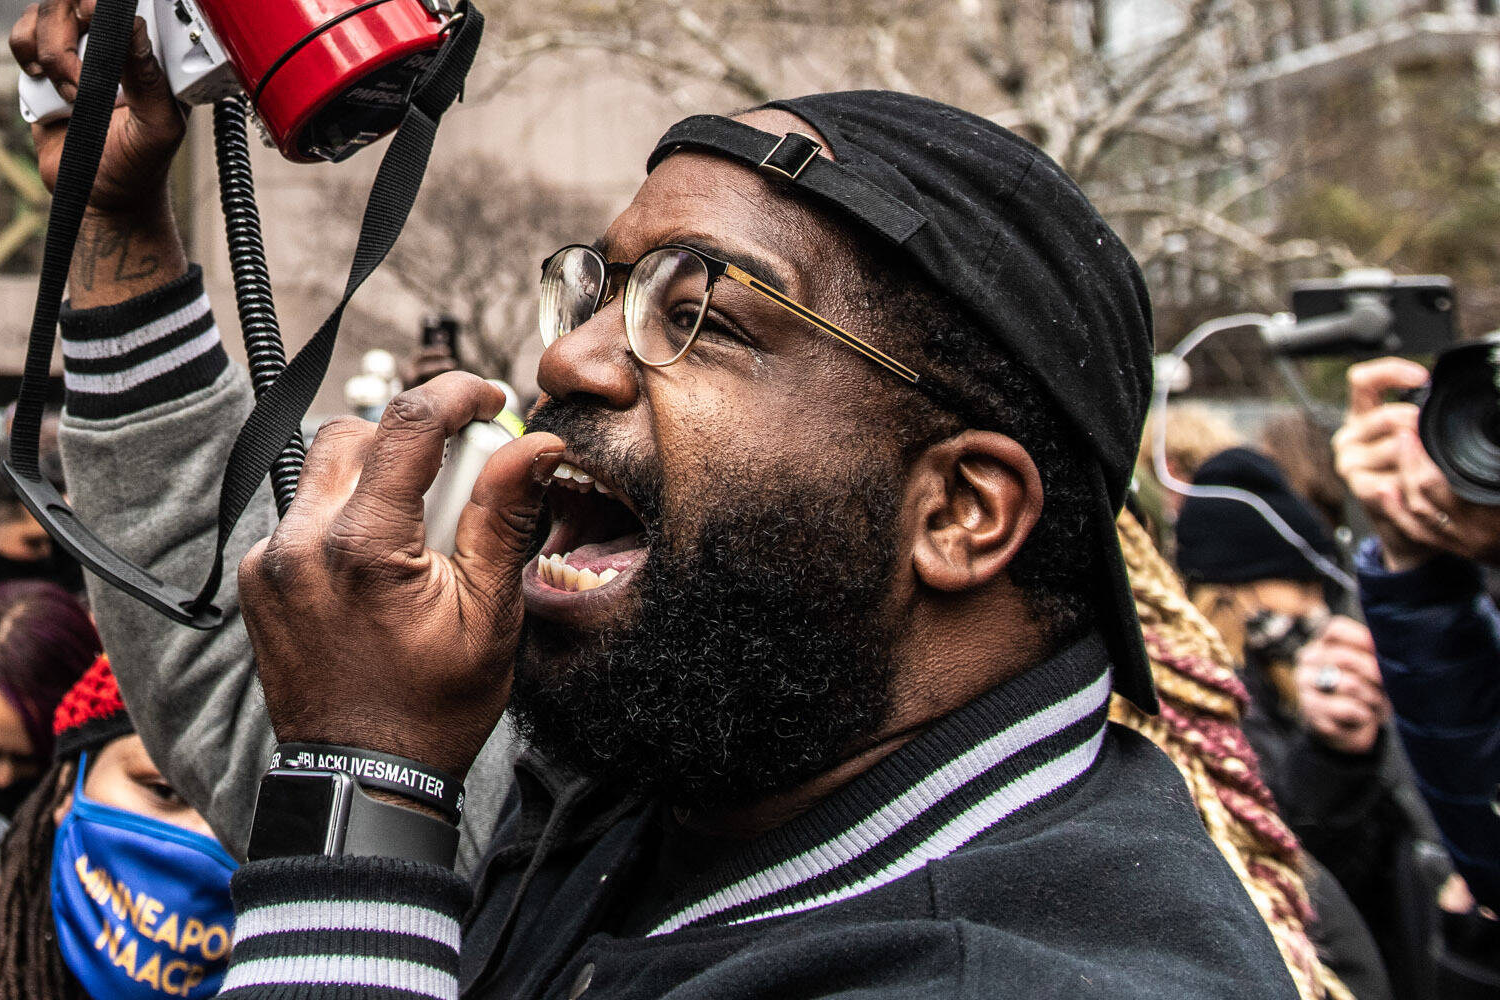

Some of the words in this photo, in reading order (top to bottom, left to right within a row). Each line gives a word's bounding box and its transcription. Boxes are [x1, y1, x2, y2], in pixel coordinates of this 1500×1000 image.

[297, 751, 445, 799] #BLACKLIVESMATTER
[75, 854, 234, 961] MINNEAPO
[94, 919, 204, 998] NAACP
